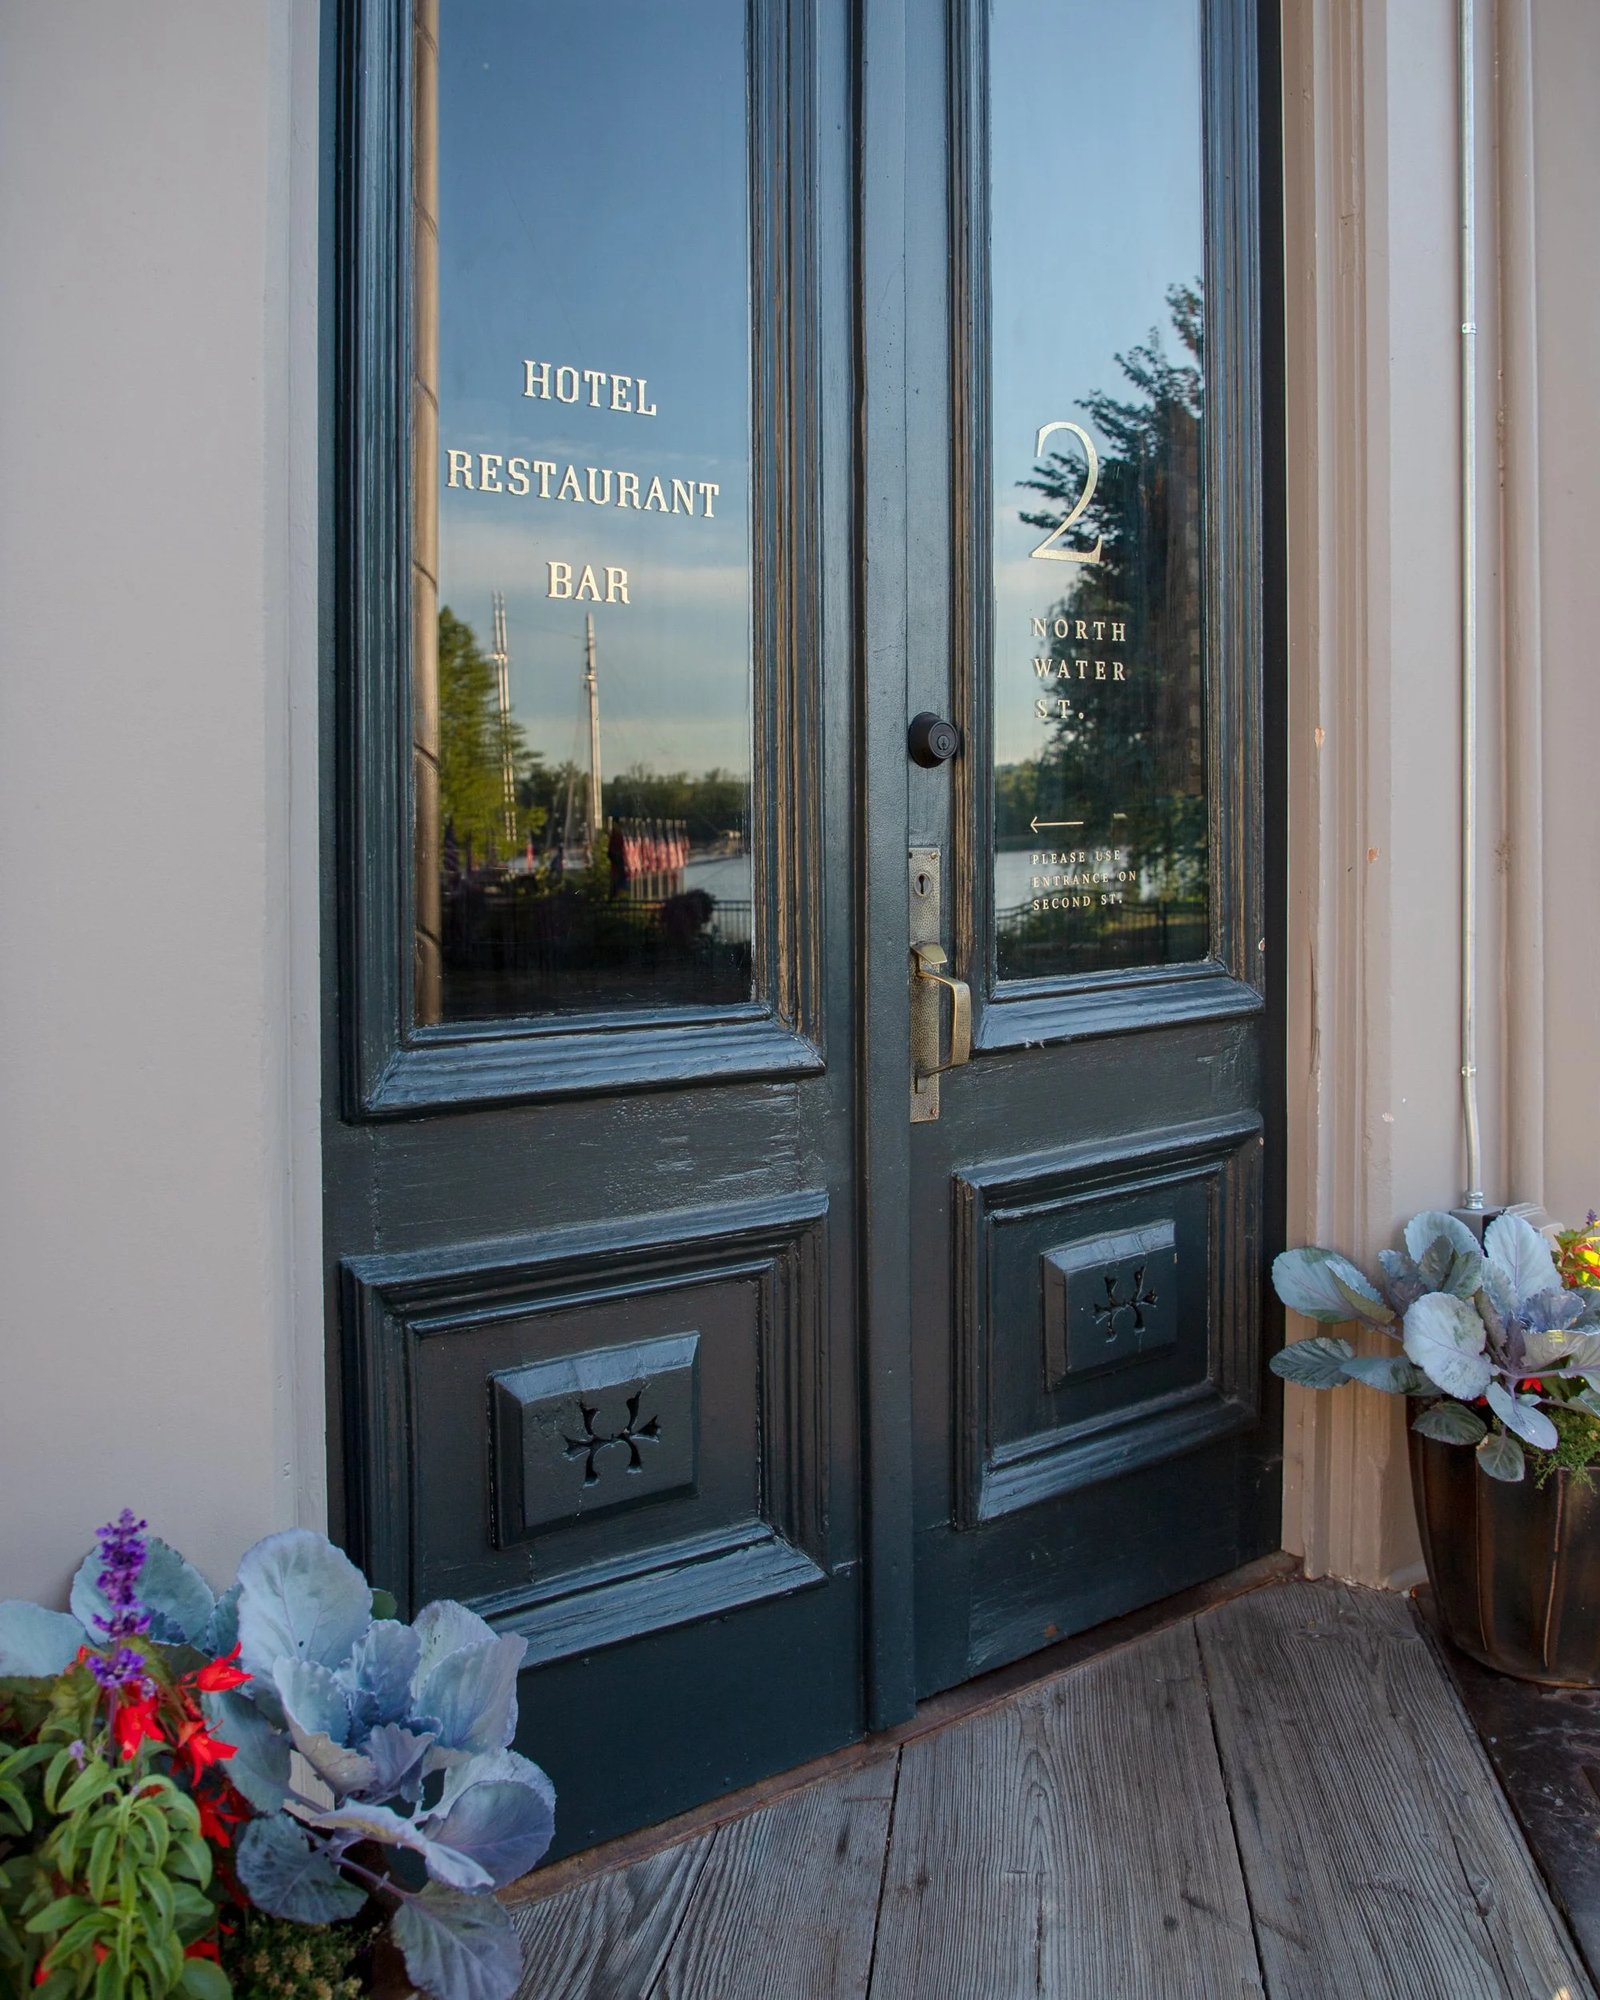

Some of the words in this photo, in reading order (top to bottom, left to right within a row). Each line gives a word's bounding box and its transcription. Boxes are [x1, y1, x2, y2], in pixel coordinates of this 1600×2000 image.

[522, 360, 657, 416] HOTEL
[446, 449, 720, 518] RESTAURANT
[1031, 421, 1103, 564] 2
[547, 561, 631, 604] BAR
[1032, 617, 1127, 642] NORTH
[1033, 658, 1127, 681] WATER
[1035, 699, 1085, 720] ST.
[1031, 851, 1085, 865] PLEASE
[1095, 850, 1121, 861] USE
[1032, 872, 1109, 888] ENTRANCE
[1118, 870, 1137, 882] ON
[1033, 896, 1091, 911] SECOND
[1101, 894, 1123, 905] ST.
